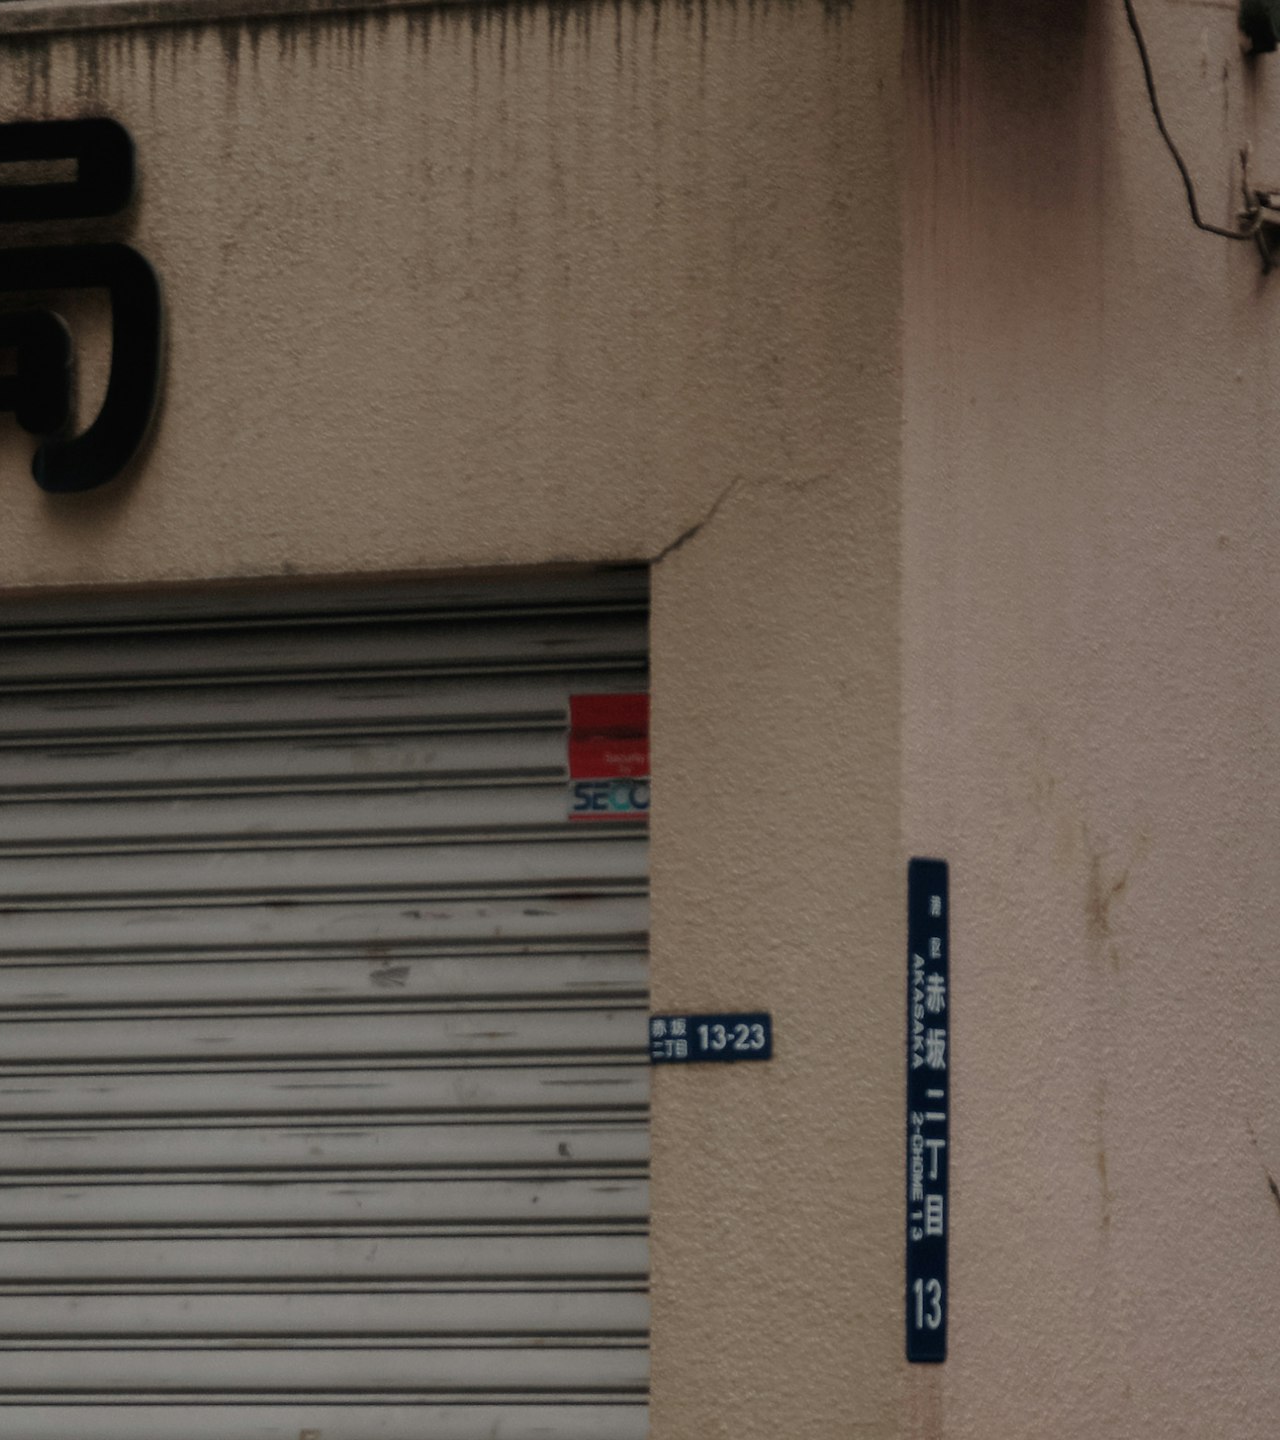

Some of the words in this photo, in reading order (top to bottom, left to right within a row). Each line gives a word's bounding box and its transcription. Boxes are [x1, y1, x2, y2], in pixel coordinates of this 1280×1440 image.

[912, 953, 925, 1069] AKASAKA
[651, 1038, 688, 1058] 二丁目
[697, 1023, 766, 1051] 13-23
[911, 1111, 924, 1201] 2-CHOME
[910, 1209, 924, 1241] 13
[912, 1278, 942, 1330] 13
